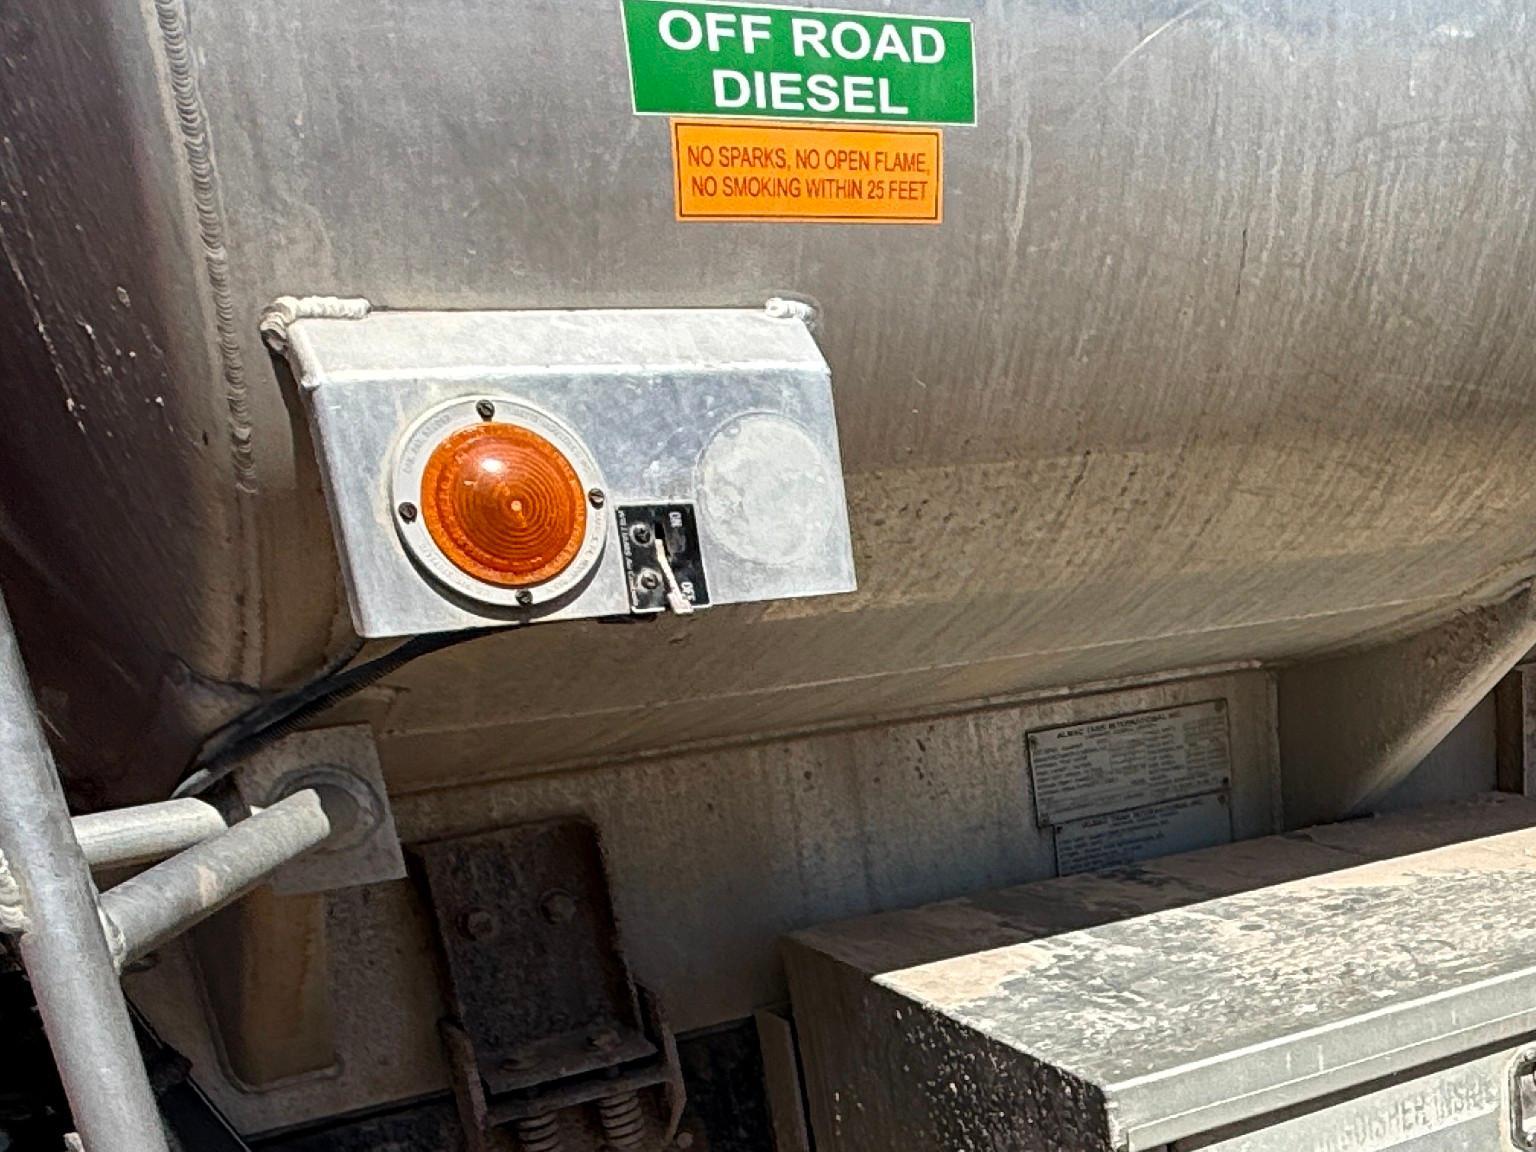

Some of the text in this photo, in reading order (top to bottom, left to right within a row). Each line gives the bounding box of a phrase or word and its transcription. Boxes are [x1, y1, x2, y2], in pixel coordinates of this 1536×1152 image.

[658, 9, 945, 64] OFF ROAD
[712, 69, 908, 114] DIESEL
[687, 145, 930, 176] NO SPARKS, NO OPEN FLAME,
[692, 175, 929, 201] NO SMOKING WITHIN 25 FEET
